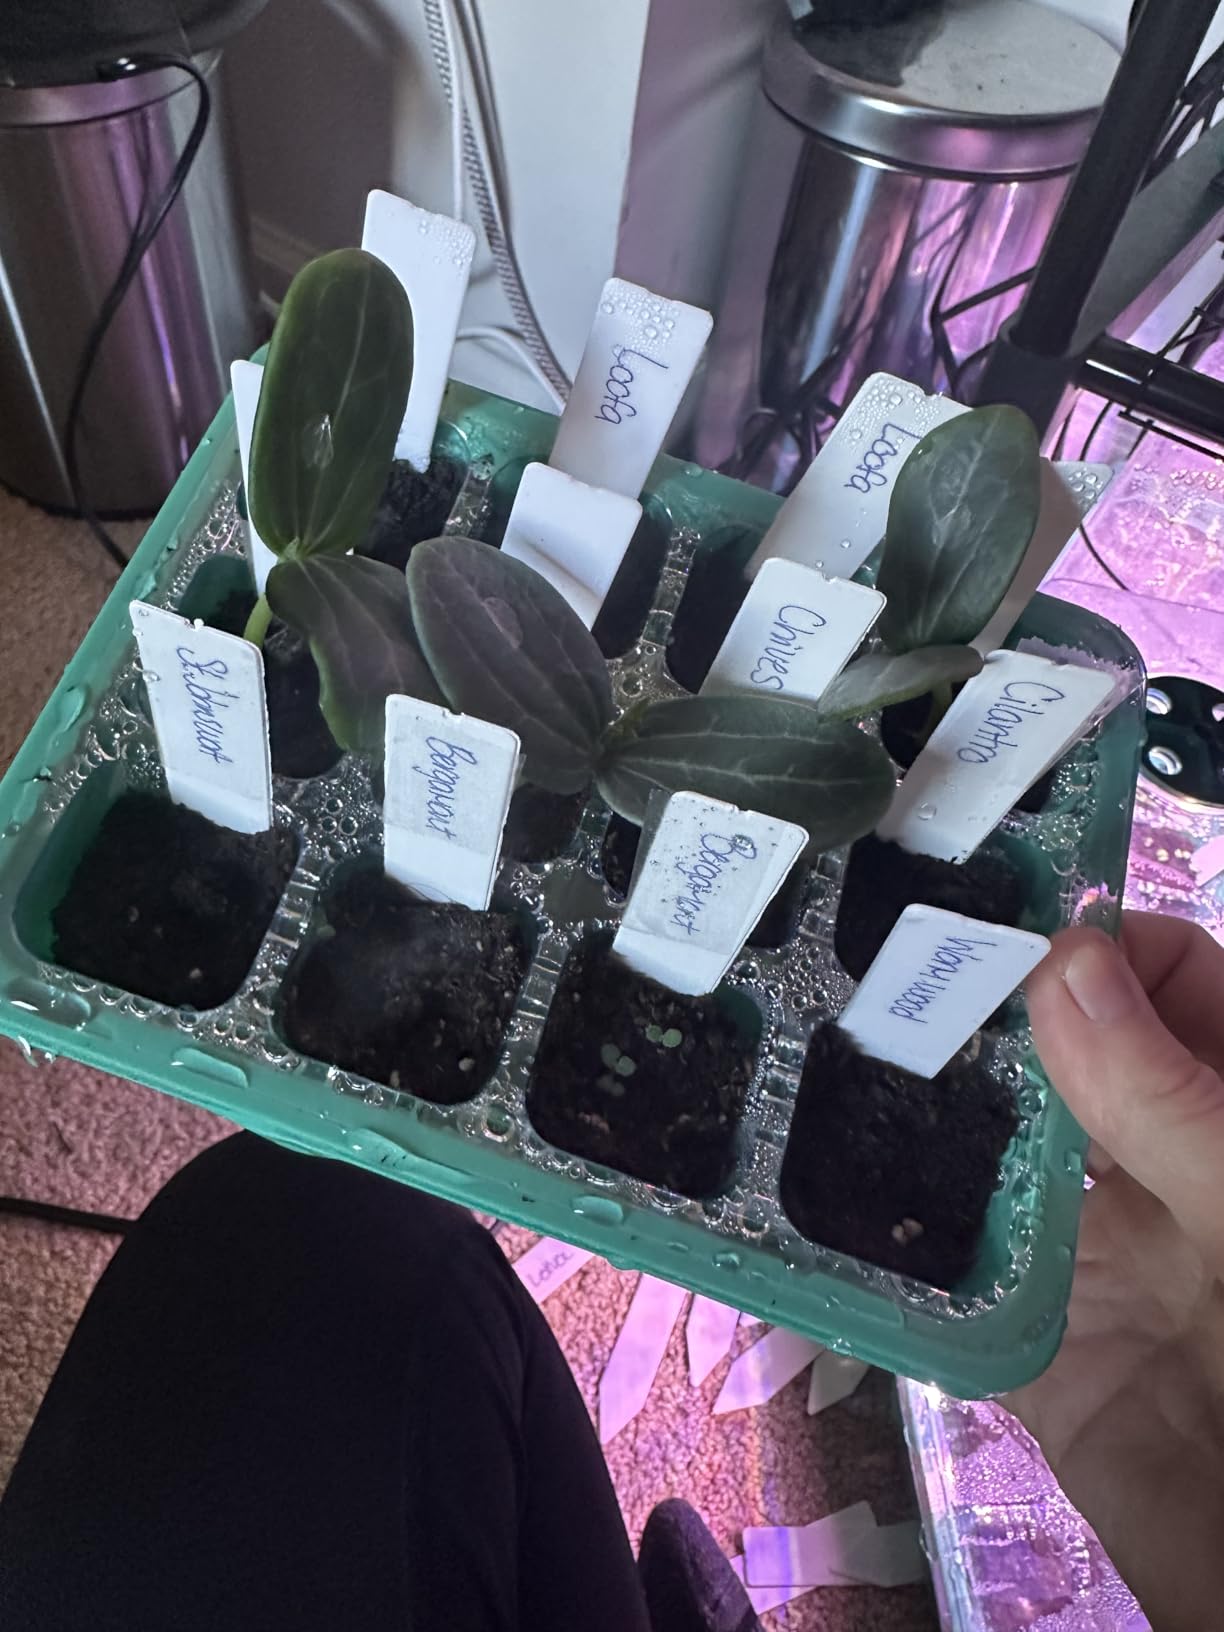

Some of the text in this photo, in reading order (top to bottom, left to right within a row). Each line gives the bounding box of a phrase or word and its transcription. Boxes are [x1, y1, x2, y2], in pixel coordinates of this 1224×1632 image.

[594, 347, 670, 425] Loofa
[843, 422, 925, 494] Loofa
[750, 604, 827, 690] Chives
[956, 680, 1066, 765] Cilantro
